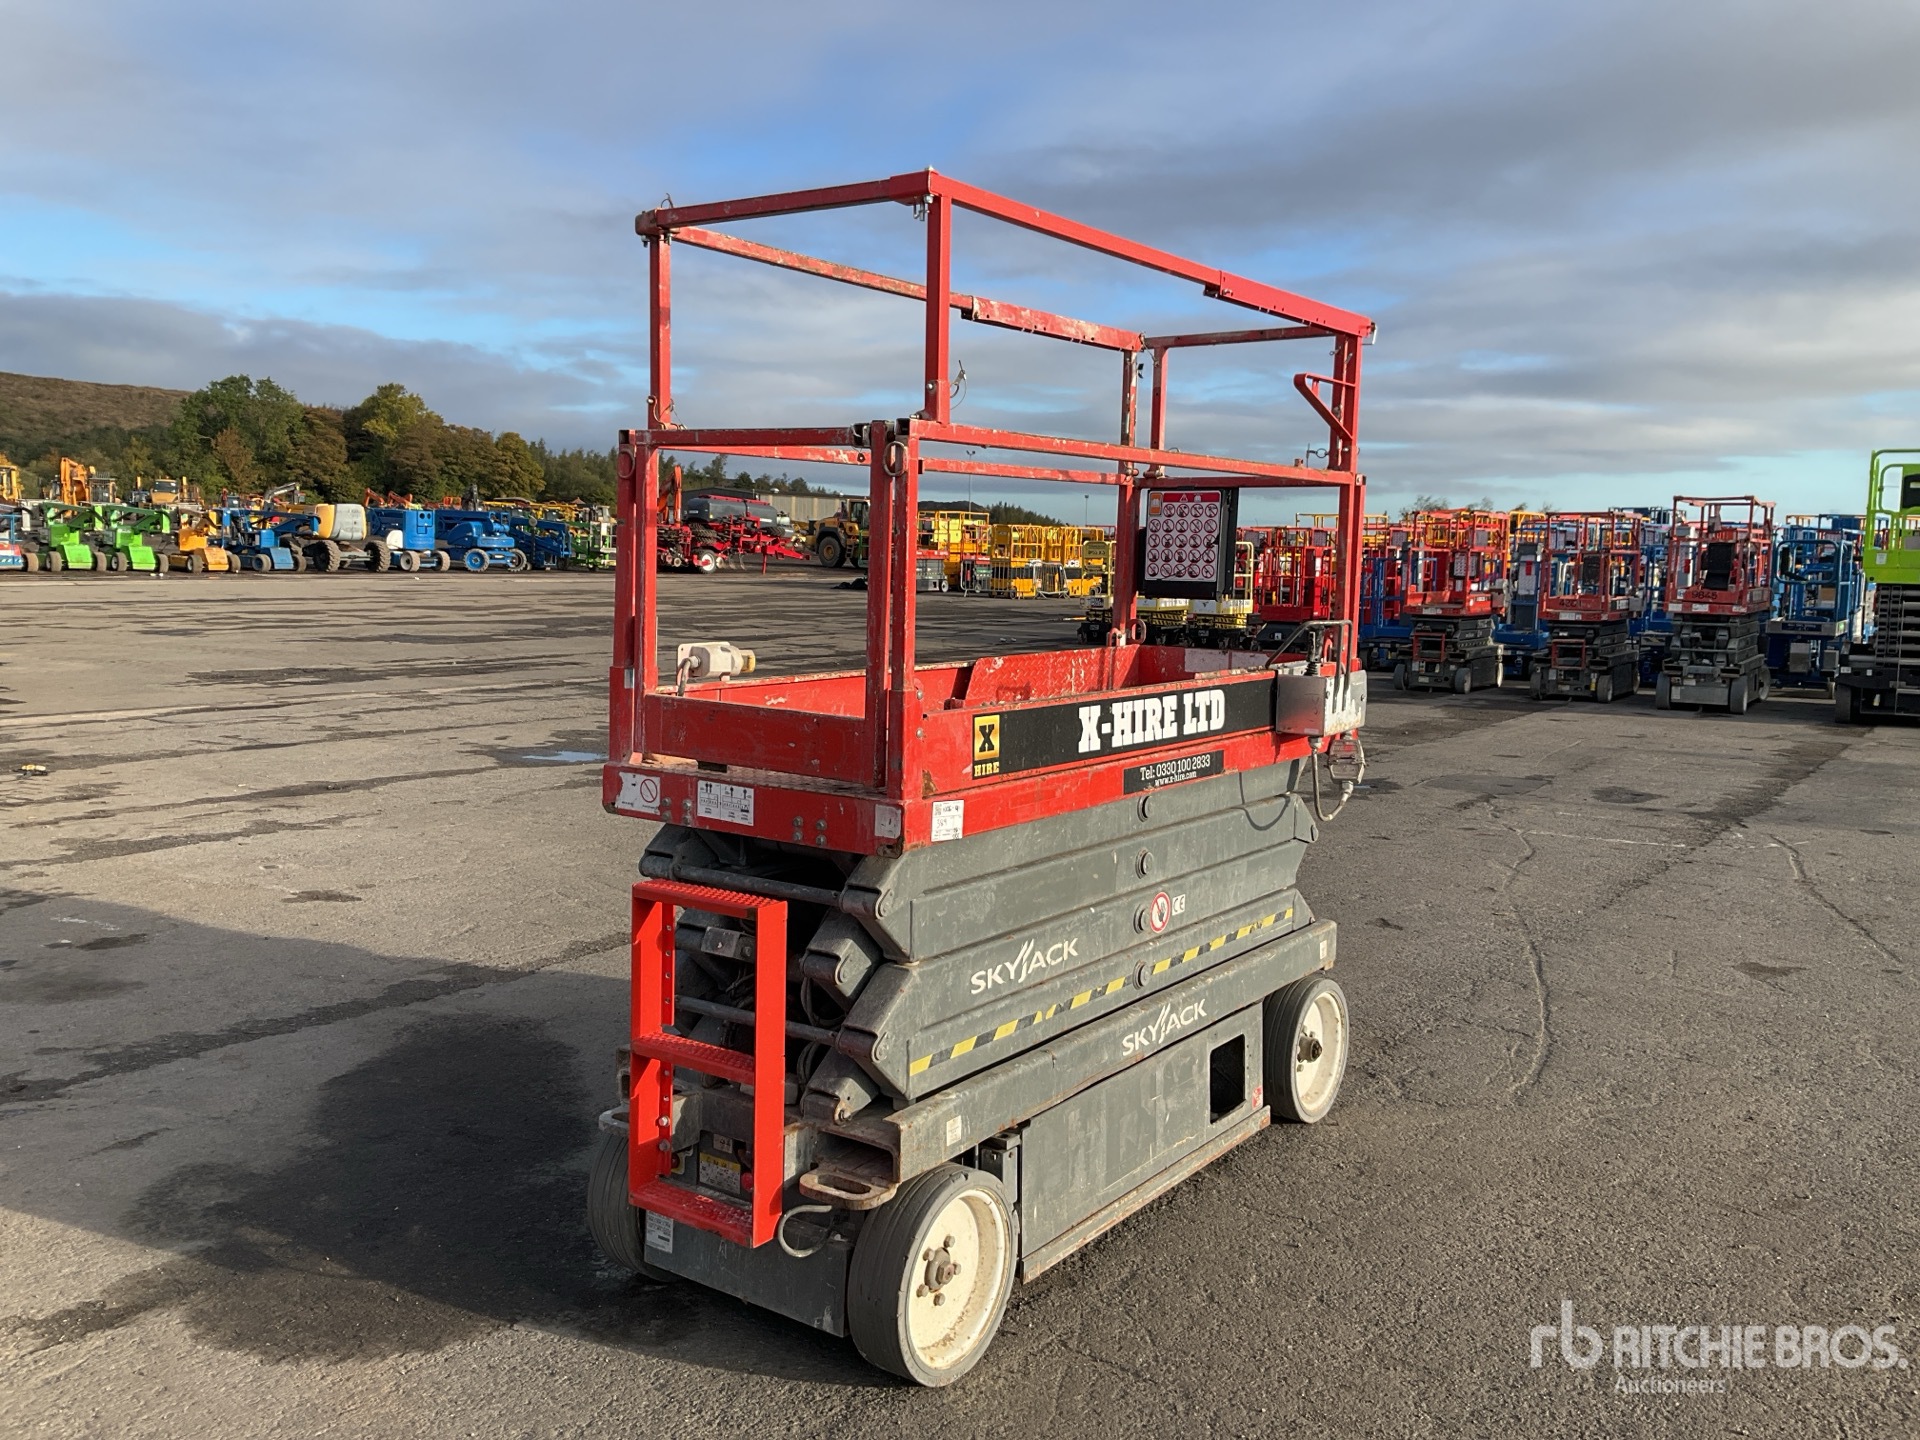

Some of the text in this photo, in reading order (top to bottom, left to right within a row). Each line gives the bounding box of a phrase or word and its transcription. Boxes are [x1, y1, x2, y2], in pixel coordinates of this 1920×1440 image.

[1078, 688, 1226, 754] X-HIRE LTD
[978, 723, 996, 753] X
[973, 761, 1000, 778] HIRE
[1140, 753, 1211, 781] Tel: 0330 100 2833
[1154, 771, 1196, 786] www.x-hire.com
[970, 938, 1079, 995] SKYJACK
[1121, 999, 1210, 1057] SKYJACK
